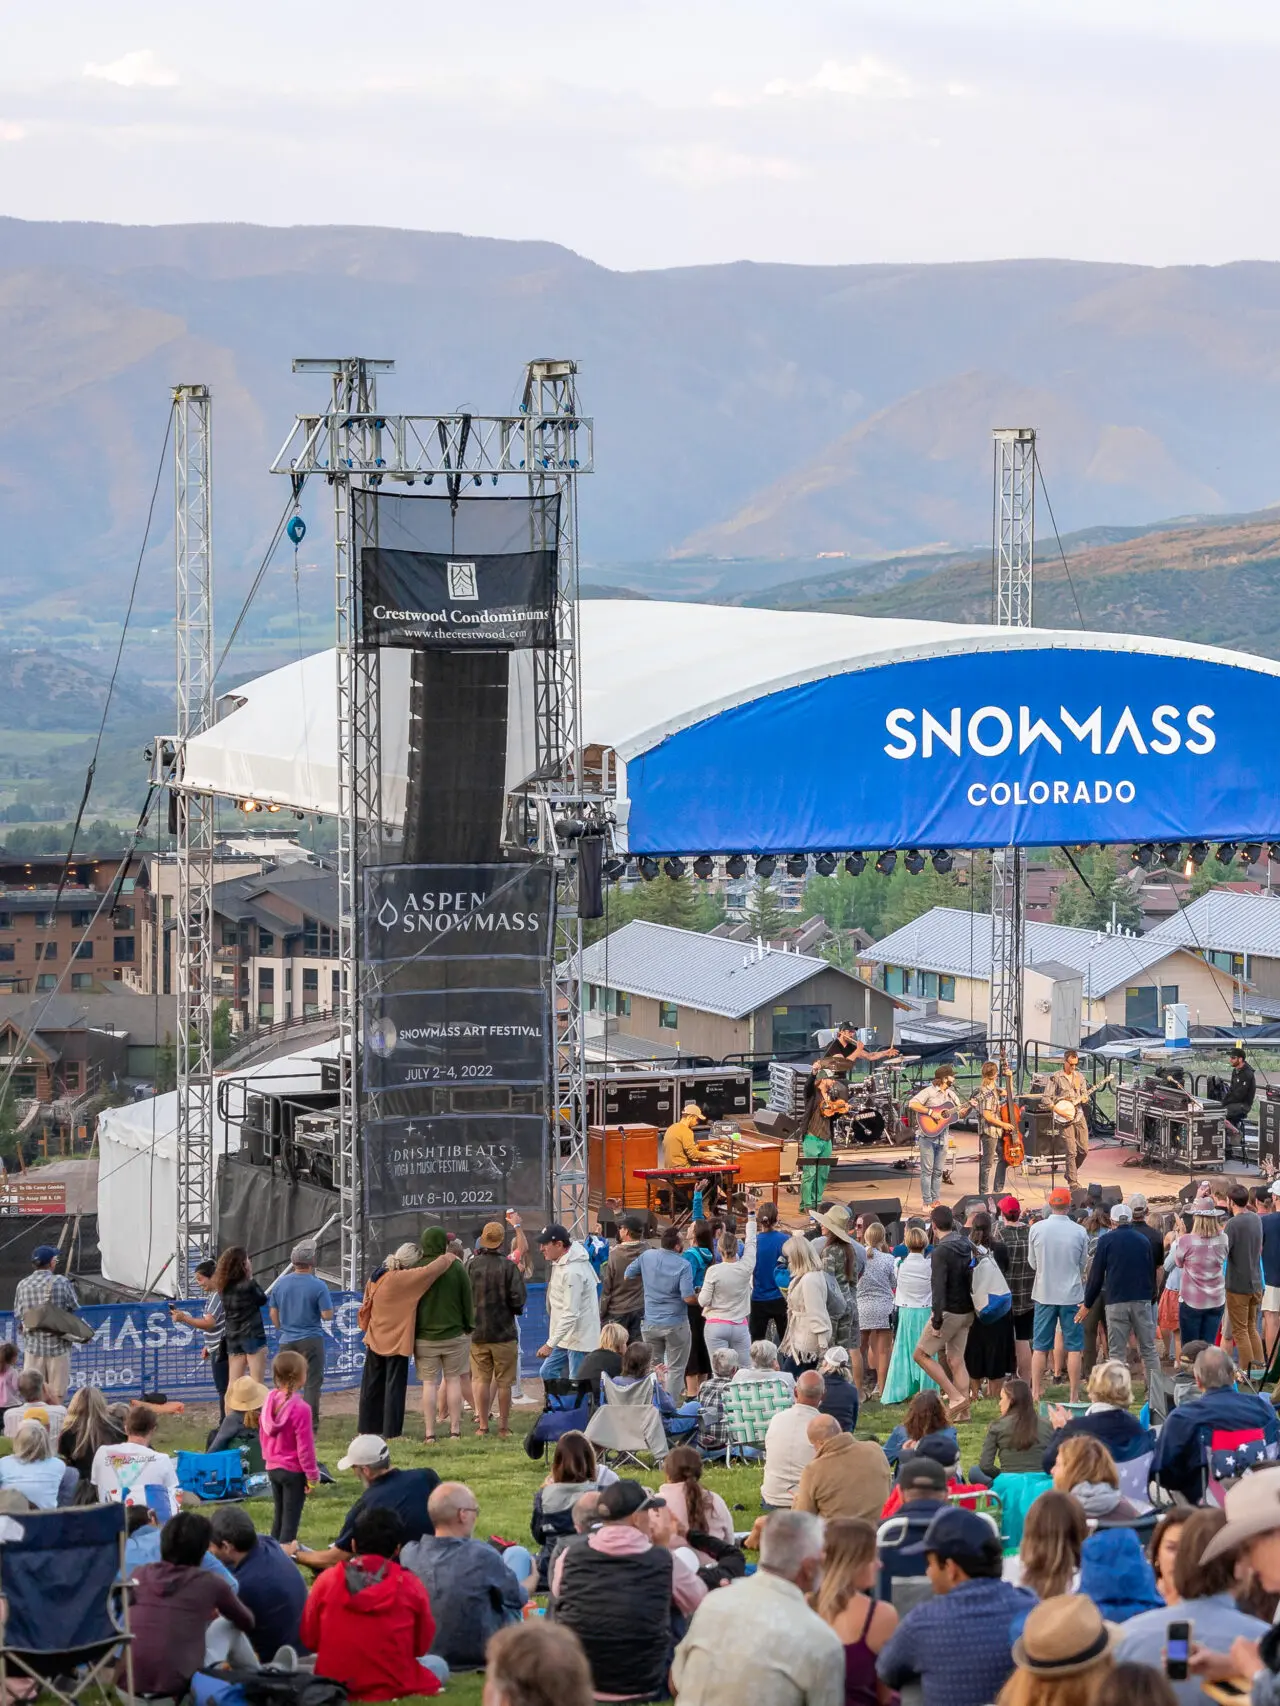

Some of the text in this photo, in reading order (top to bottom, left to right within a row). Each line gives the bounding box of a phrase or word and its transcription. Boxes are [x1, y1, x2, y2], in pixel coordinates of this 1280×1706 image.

[373, 605, 448, 622] Crestwood
[883, 704, 1216, 760] SNOWMASS
[967, 780, 1136, 807] COLORADO
[403, 891, 486, 911] ASPEN
[403, 912, 539, 933] SNOWMASS
[399, 1025, 542, 1040] SNOWMASS ART FESTIVAL
[404, 1067, 430, 1081] JULY
[461, 1065, 493, 1077] 2022
[393, 1144, 507, 1162] DRISHTIBEATS
[415, 1160, 437, 1175] MUSIC
[438, 1159, 470, 1174] FESTIVAL
[402, 1190, 493, 1207] JULY 8-10, 2022
